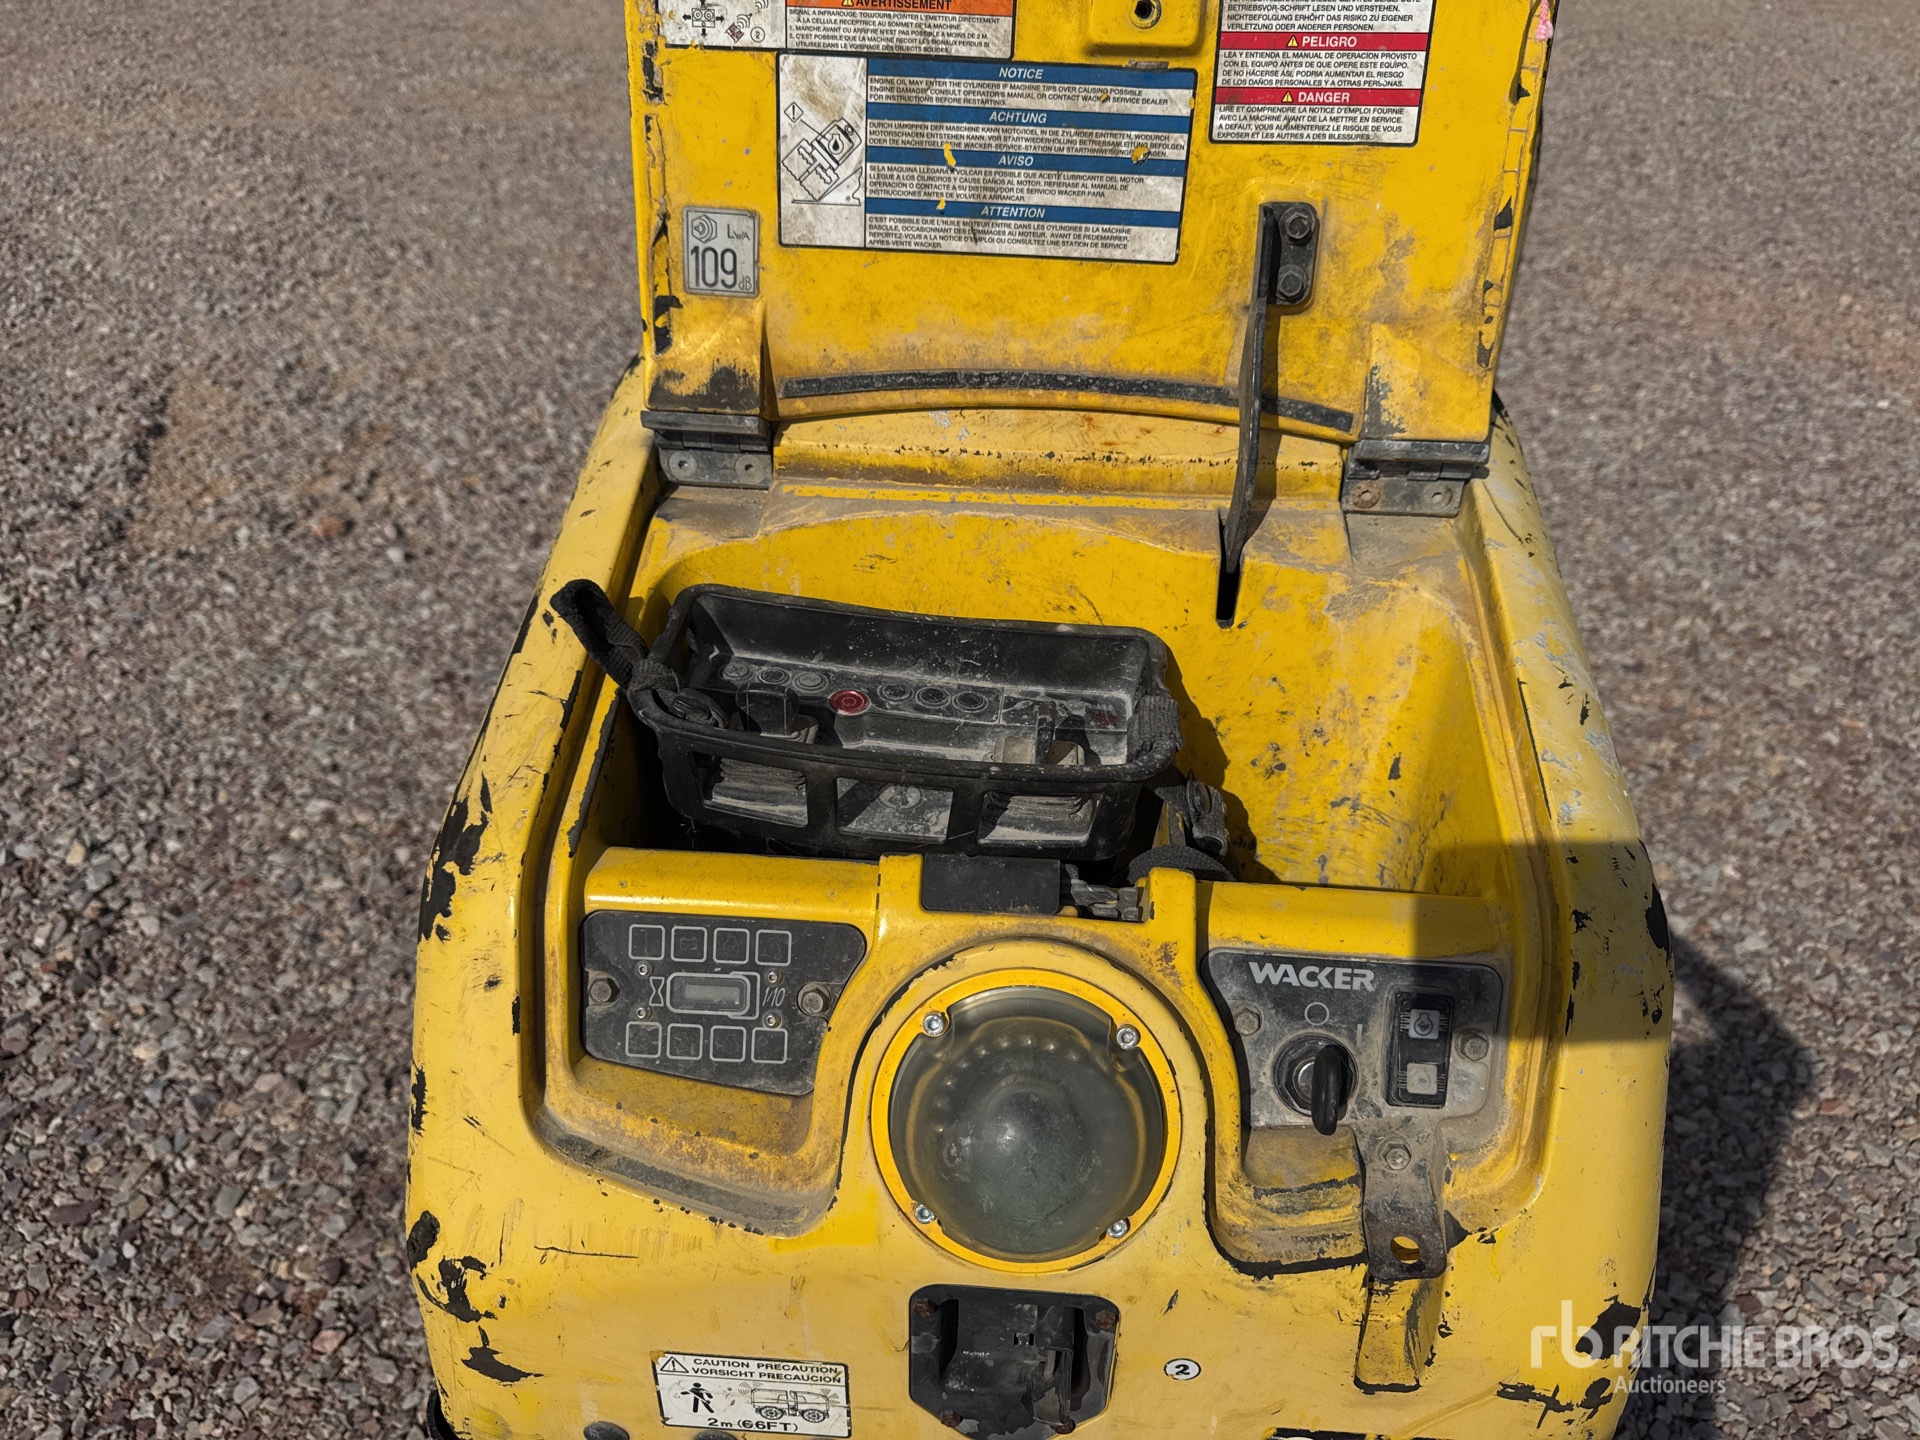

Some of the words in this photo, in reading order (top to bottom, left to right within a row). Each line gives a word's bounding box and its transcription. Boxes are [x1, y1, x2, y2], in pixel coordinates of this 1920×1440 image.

[1326, 14, 1342, 22] DAS
[1343, 14, 1368, 22] RISIKO
[1275, 23, 1296, 31] ODER
[1296, 23, 1332, 31] ANDERER
[1302, 36, 1357, 47] PELIGRO
[1223, 60, 1240, 68] CON
[1333, 61, 1358, 69] OPERE
[1360, 61, 1378, 69] ESTE
[998, 67, 1044, 79] NOTICE
[1325, 70, 1364, 78] AUMENTAR
[870, 77, 895, 85] ENGINE
[963, 82, 1001, 90] CYLINDERS
[1010, 84, 1041, 92] MACHINE
[1042, 85, 1057, 93] TIPS
[1110, 88, 1143, 96] POSSIBLE
[1248, 78, 1273, 86] DAÑOS
[1275, 79, 1323, 87] PERSONALES
[885, 95, 934, 103] INSTRUCTIONS
[1081, 95, 1111, 103] WACKR
[1298, 92, 1351, 103] DANGER
[989, 111, 1048, 124] ACHTUNG
[1371, 116, 1403, 124] SERVICE.
[1225, 124, 1253, 132] DEFAUT,
[1275, 124, 1331, 132] AUGMENTERIEZ
[998, 155, 1034, 166] AVISO
[981, 206, 1046, 218] ATTENTION
[690, 246, 737, 289] 109
[738, 276, 752, 291] dB
[1248, 961, 1376, 993] WACKER
[762, 987, 785, 1008] 1/10
[693, 1358, 750, 1369] CAUTION
[757, 1362, 839, 1374] PRECAUTION
[1174, 1364, 1190, 1376] 2
[692, 1367, 755, 1378] VORSICHT
[759, 1372, 841, 1384] PRECAUCION
